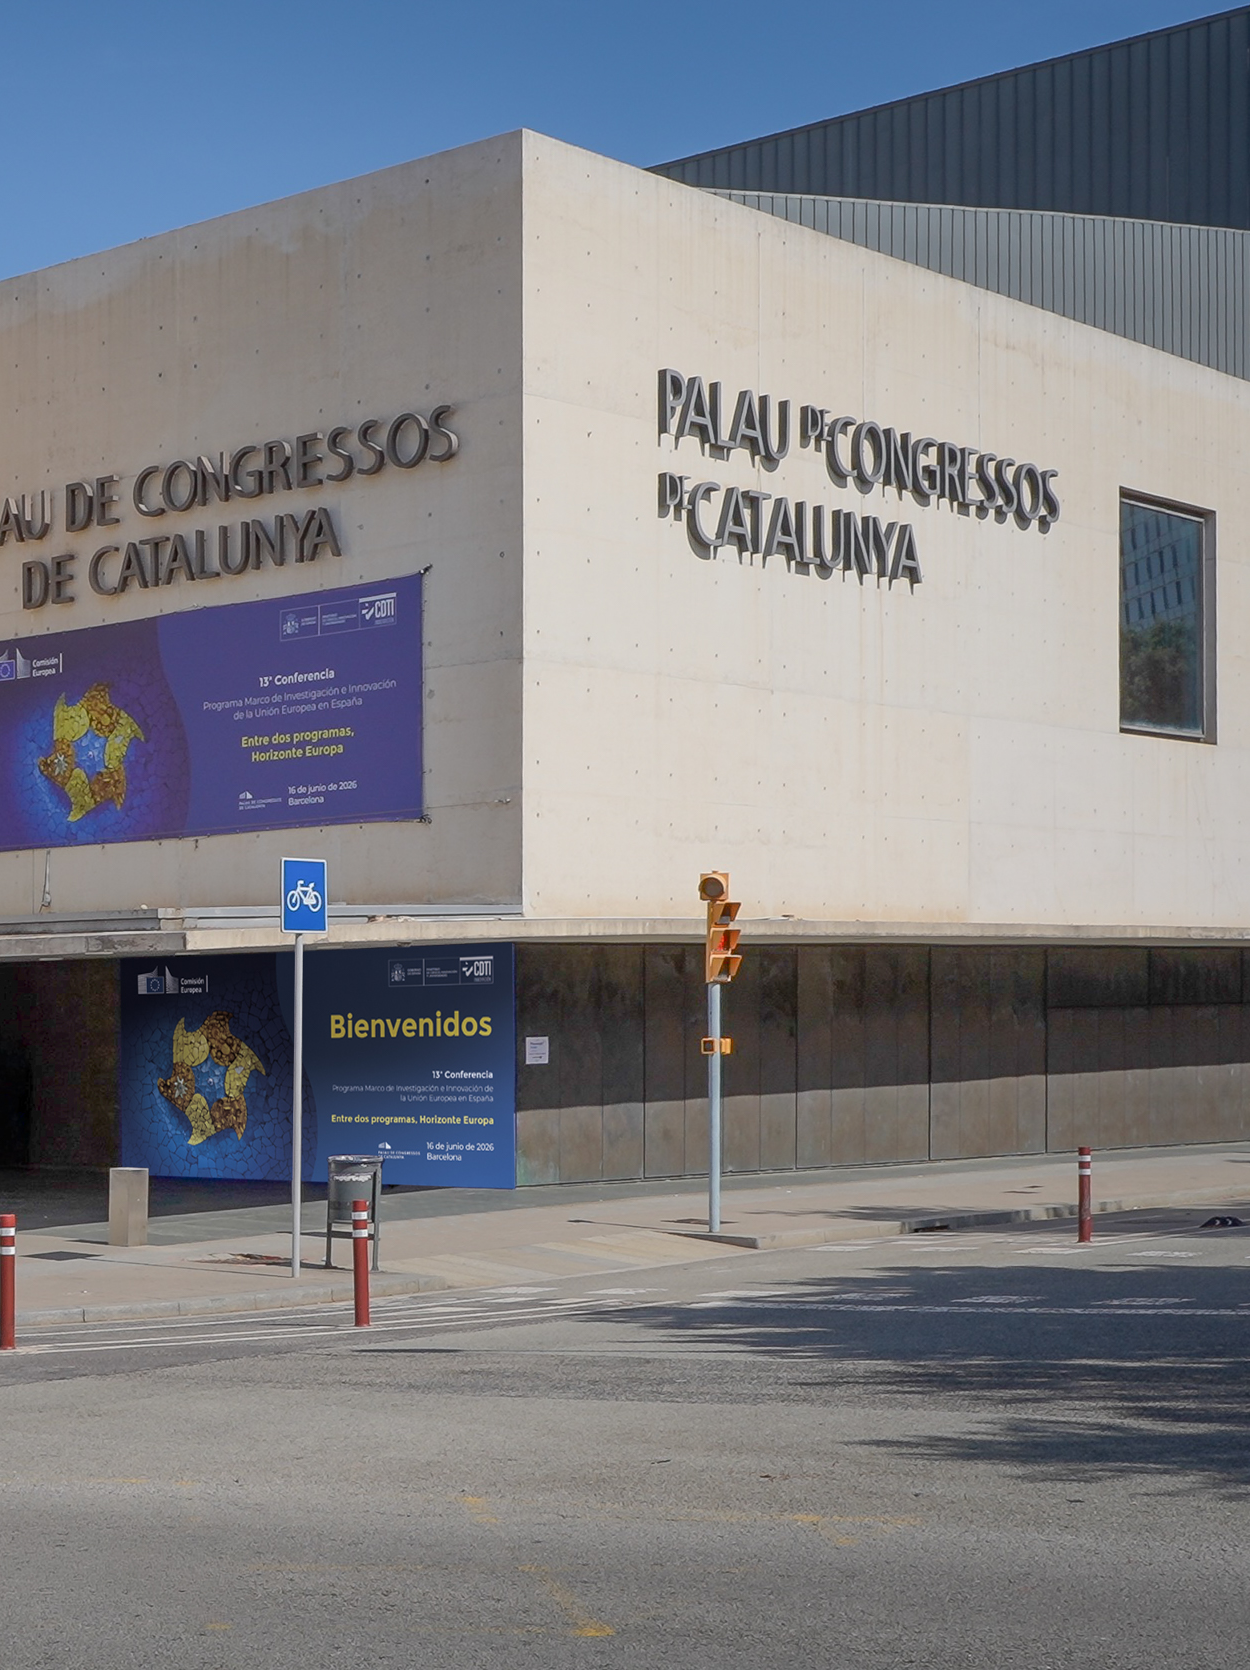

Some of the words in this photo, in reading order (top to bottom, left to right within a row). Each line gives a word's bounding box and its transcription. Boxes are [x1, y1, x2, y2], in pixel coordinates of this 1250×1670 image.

[658, 368, 791, 473] PALAU
[800, 404, 832, 453] DE
[826, 415, 1061, 535] CONGRESSOS
[65, 474, 121, 532] DE
[133, 405, 459, 517] CONGRESSOS
[657, 472, 692, 521] DE
[686, 481, 923, 595] CATALUNYA
[22, 553, 76, 610] DE
[89, 507, 342, 596] CATALUNYA
[374, 599, 395, 618] CDTI
[32, 657, 59, 668] Comisión
[32, 668, 56, 677] Europea
[274, 668, 335, 686] Conferencia
[203, 699, 243, 712] Programa
[244, 696, 270, 706] Marco
[271, 693, 283, 703] de
[284, 685, 340, 702] Investigación
[341, 686, 348, 694] e
[349, 679, 397, 693] Innovación
[233, 710, 245, 720] de
[246, 708, 253, 719] la
[255, 706, 280, 718] Unión
[282, 702, 317, 716] Europea
[318, 701, 329, 710] en
[331, 697, 363, 710] España
[241, 736, 269, 747] Entre
[272, 733, 291, 744] dos
[294, 727, 355, 744] programas,
[251, 747, 303, 762] Horizonte
[306, 744, 344, 756] Europa
[288, 786, 296, 794] 16
[297, 785, 307, 794] de
[308, 783, 326, 794] junio
[328, 782, 337, 791] de
[339, 780, 358, 790] 2026
[288, 795, 325, 806] Barcelona
[474, 961, 491, 976] CDTI
[180, 977, 204, 985] Comisión
[330, 1011, 492, 1039] Bienvenidos
[444, 1070, 493, 1079] Conferencia
[332, 1084, 364, 1094] Programa
[365, 1084, 385, 1092] Marco
[386, 1084, 394, 1092] de
[396, 1084, 439, 1093] Investigación
[446, 1084, 483, 1092] Innovación
[484, 1084, 494, 1092] de
[400, 1094, 406, 1102] la
[407, 1094, 428, 1102] Unión
[429, 1094, 457, 1103] Europea
[468, 1094, 494, 1103] España
[331, 1114, 353, 1123] Entre
[354, 1114, 369, 1123] dos
[371, 1115, 418, 1125] programas,
[420, 1115, 461, 1124] Horizonte
[463, 1115, 494, 1126] Europa
[426, 1142, 434, 1150] 16
[435, 1142, 445, 1150] de
[446, 1142, 464, 1151] junio
[465, 1142, 475, 1150] de
[476, 1142, 494, 1151] 2026
[427, 1153, 462, 1161] Barcelona
